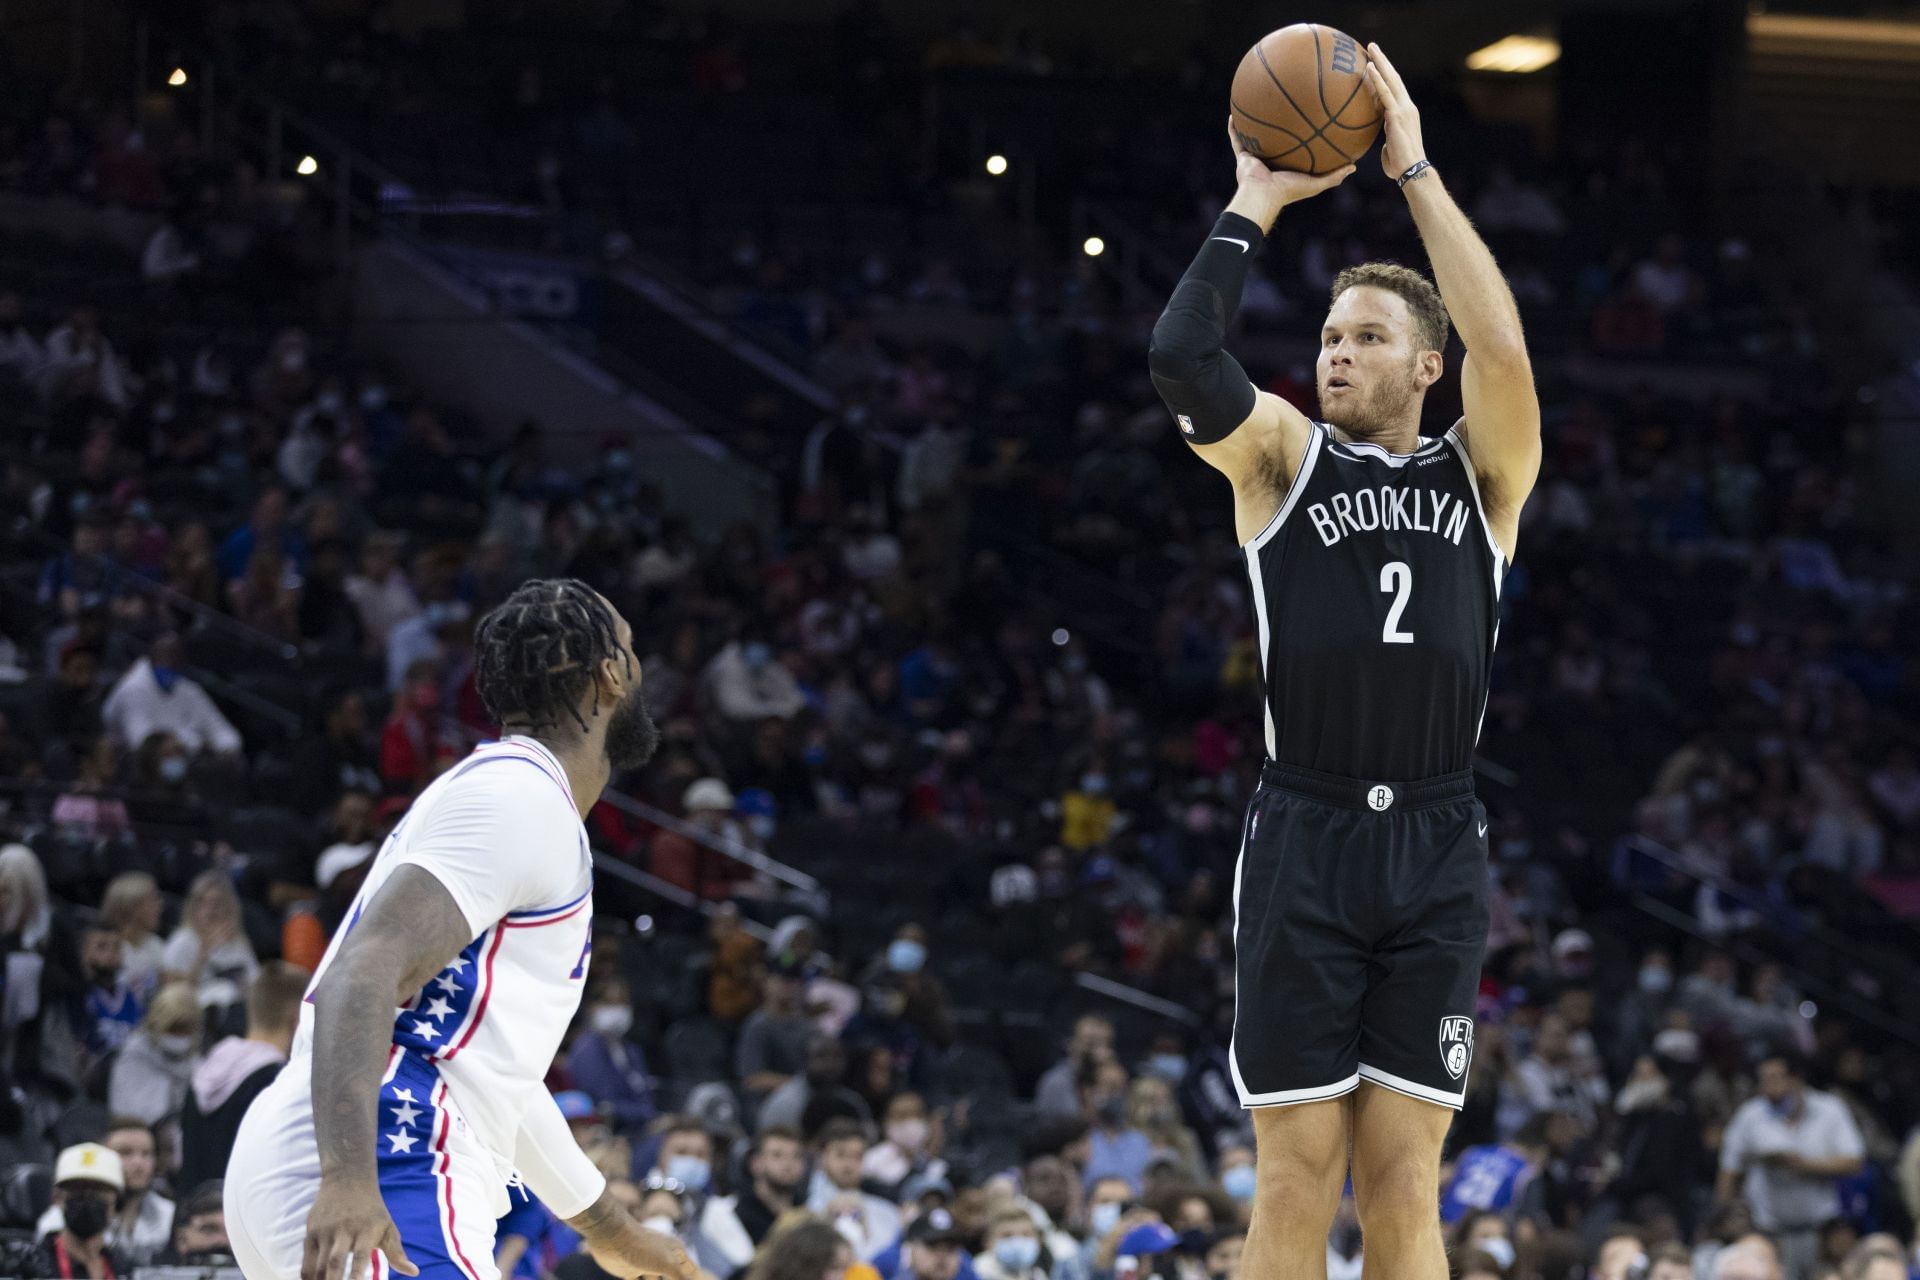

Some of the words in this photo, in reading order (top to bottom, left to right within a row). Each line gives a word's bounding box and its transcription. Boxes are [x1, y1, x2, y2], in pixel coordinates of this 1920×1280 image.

[1417, 452, 1450, 467] webull
[1307, 485, 1470, 547] BROOKLYN
[1380, 561, 1414, 643] 2
